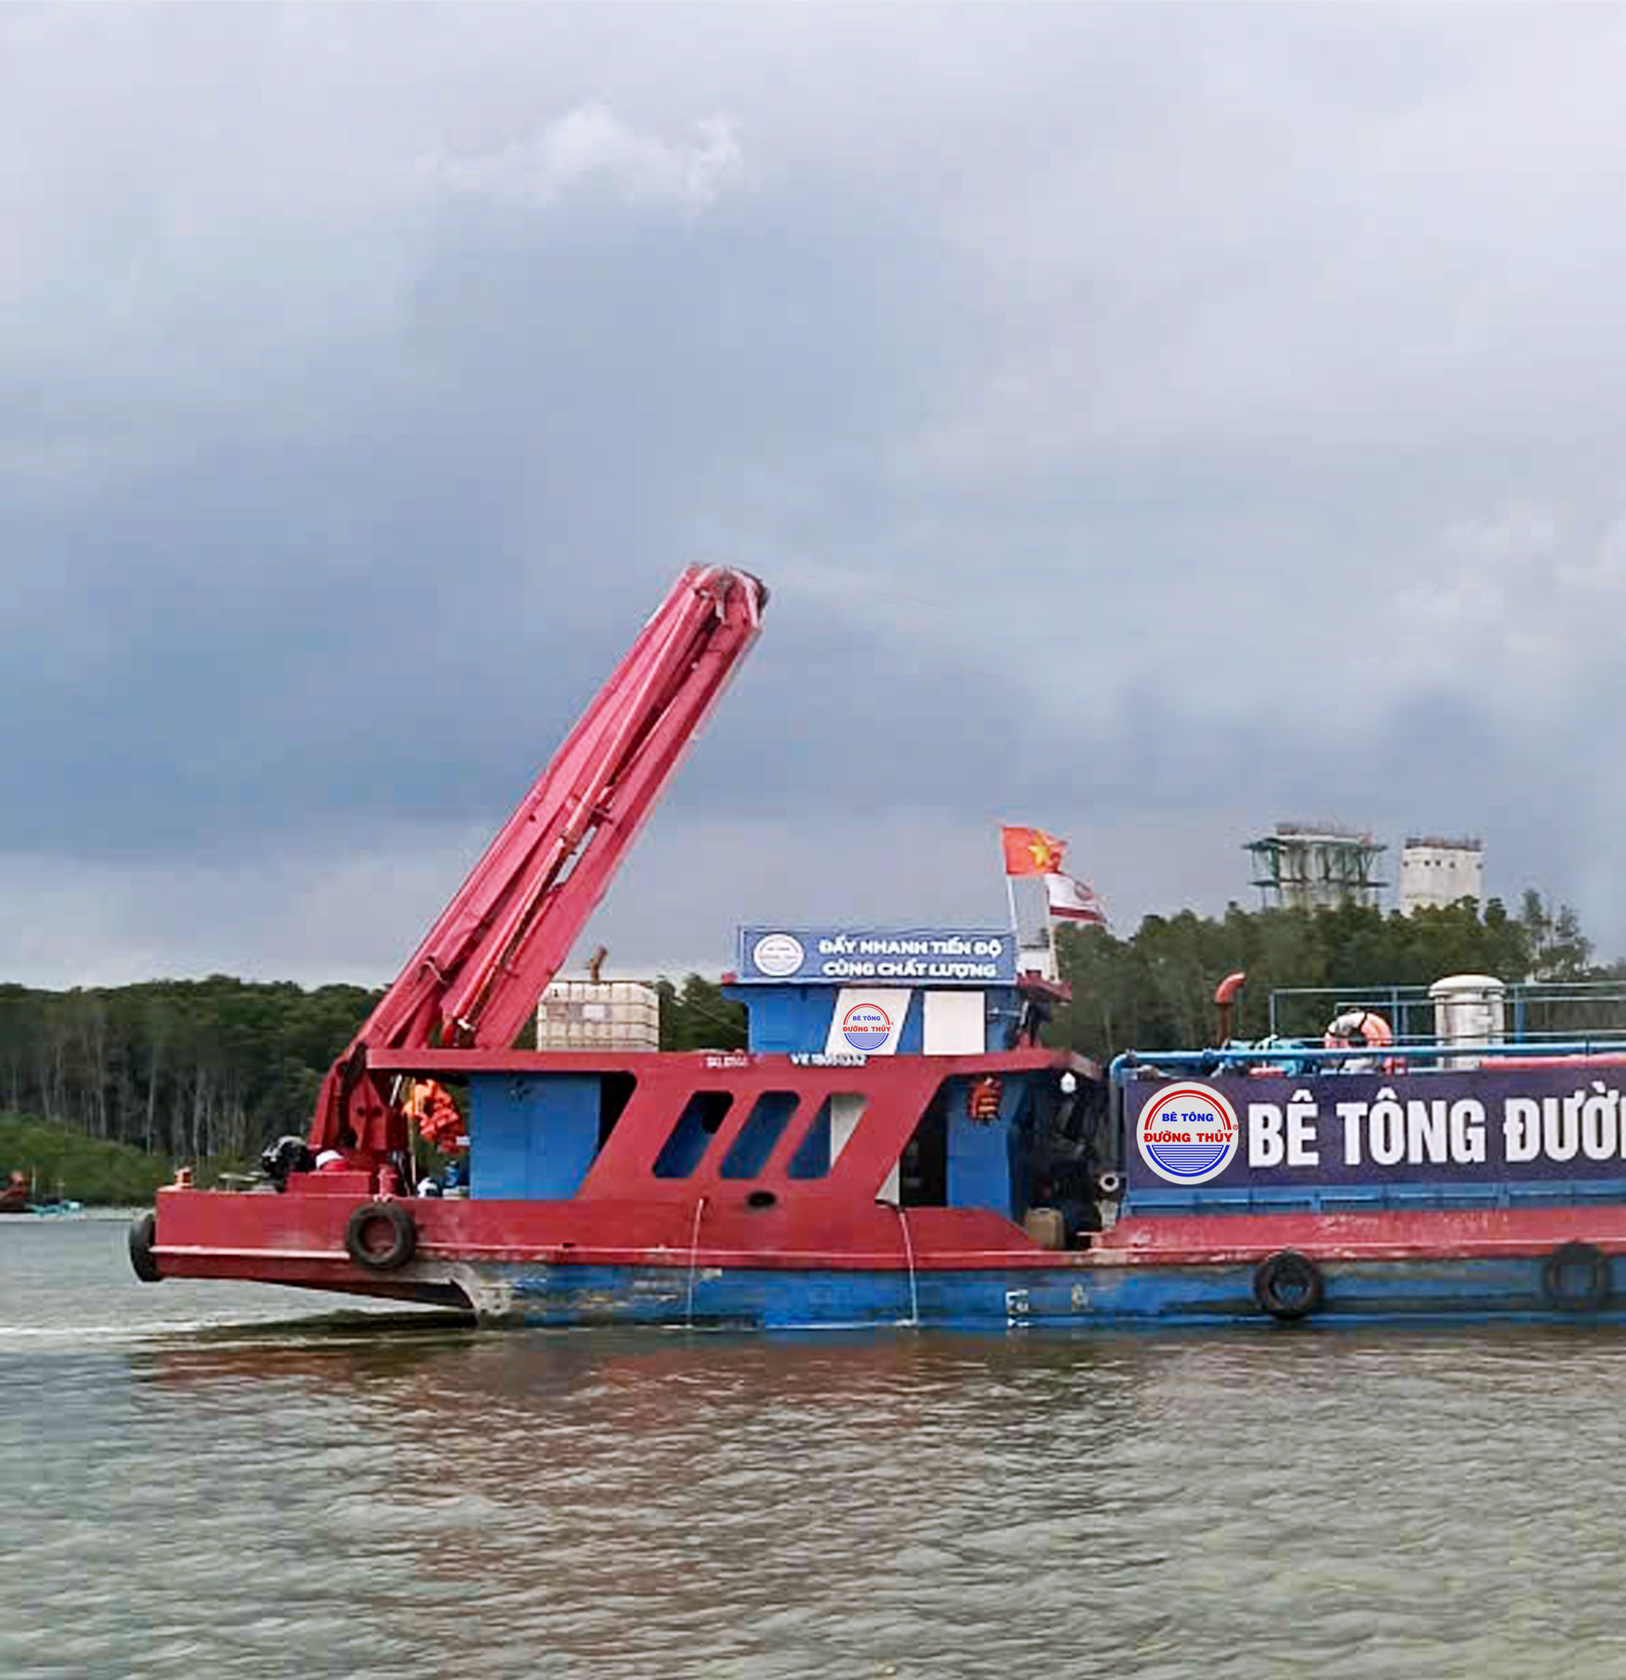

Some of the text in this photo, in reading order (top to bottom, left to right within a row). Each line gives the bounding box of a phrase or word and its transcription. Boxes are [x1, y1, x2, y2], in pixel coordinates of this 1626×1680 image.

[860, 940, 928, 954] NHANH
[974, 938, 1002, 959] ĐỘ
[877, 957, 928, 976] CHẤT
[1162, 1111, 1214, 1122] BÊ TÔNG
[1143, 1129, 1233, 1143] ĐƯỜNG THỦY
[1248, 1089, 1319, 1167] BÊ
[1336, 1086, 1486, 1165] TÔNG
